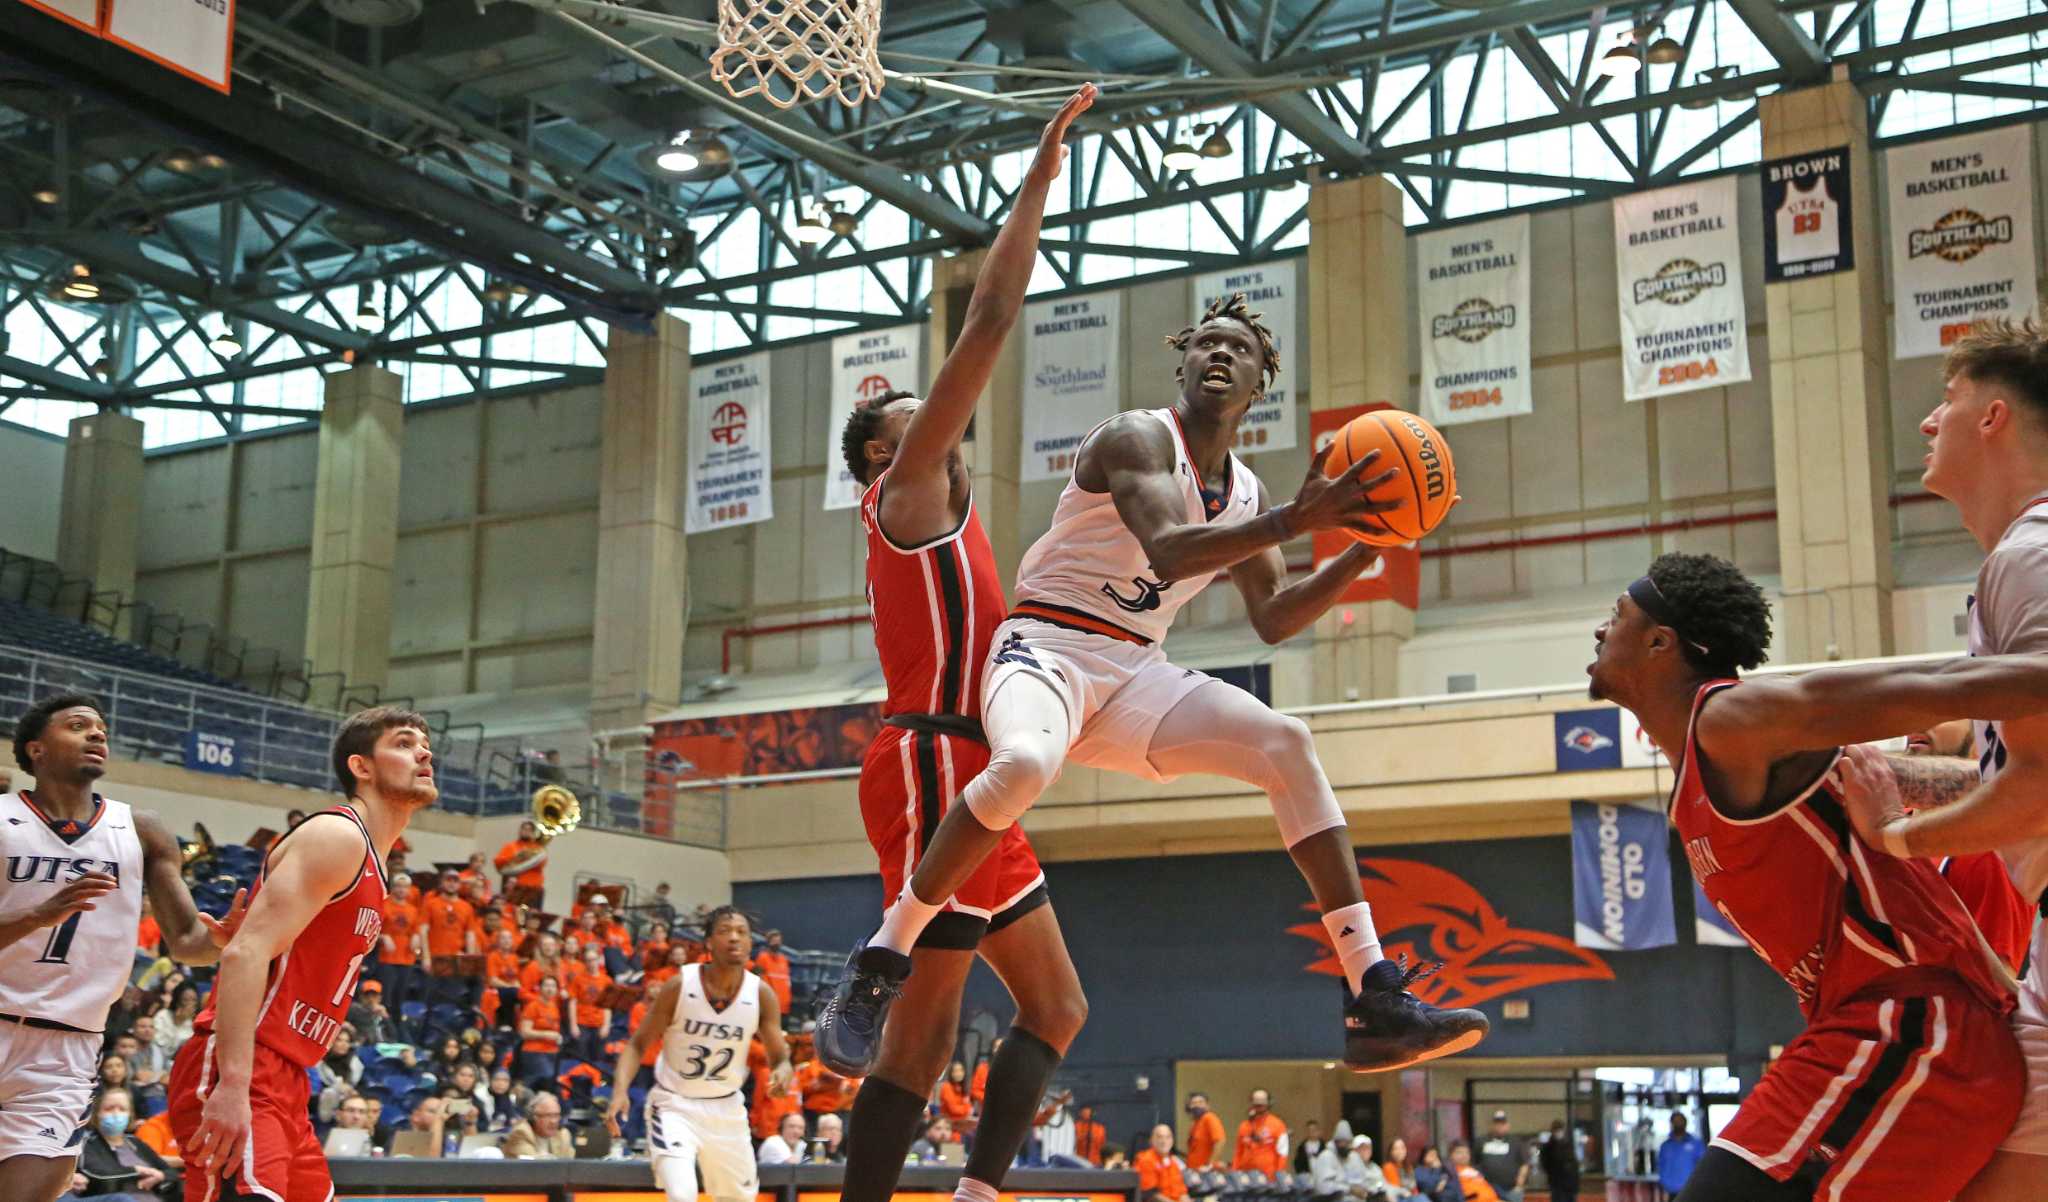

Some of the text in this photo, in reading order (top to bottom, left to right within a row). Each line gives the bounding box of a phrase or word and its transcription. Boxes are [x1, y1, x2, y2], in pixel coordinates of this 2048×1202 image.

[1770, 157, 1840, 182] BROWN
[1931, 153, 1983, 174] MEN'S
[1906, 169, 2010, 198] BASKETBALL
[1653, 203, 1698, 222] MEN'S
[1787, 200, 1825, 215] UTSA
[1629, 216, 1725, 247] BASKETBALL
[1910, 216, 2011, 258] SOUTHLAND
[1451, 240, 1493, 257] MEN'S
[1429, 254, 1517, 281] BASKETBALL
[1225, 272, 1264, 289] MEN'S
[1634, 262, 1726, 304] SOUTHLAND
[1914, 280, 2014, 306] TOURNAMENT
[1054, 301, 1090, 316] MEN'S
[1920, 297, 2009, 321] CHAMPIONS
[1034, 315, 1107, 336] BASKETBALL
[1636, 319, 1735, 349] TOURNAMENT
[859, 334, 890, 350] MEN'S
[1640, 337, 1732, 364] CHAMPIONS
[843, 348, 908, 369] BASKETBALL
[714, 363, 744, 380] MEN'S
[1035, 364, 1106, 388] Southland
[1435, 366, 1518, 388] CHAMPIONS
[1659, 358, 1718, 386] 2004
[699, 374, 759, 398] BASKETBALL
[1448, 388, 1502, 411] 2004
[1243, 409, 1282, 424] PIONS
[1034, 433, 1086, 453] CHAMP
[1401, 416, 1445, 502] Wilson
[696, 469, 763, 492] TOURNAMENT
[698, 485, 760, 506] CHAMPIONS
[197, 742, 234, 767] 106
[6, 855, 121, 890] UTSA
[1597, 804, 1625, 944] DOMINION
[1622, 841, 1647, 900] OLD
[287, 999, 343, 1051] KENT
[683, 1018, 744, 1041] UTSA
[679, 1043, 735, 1081] 32
